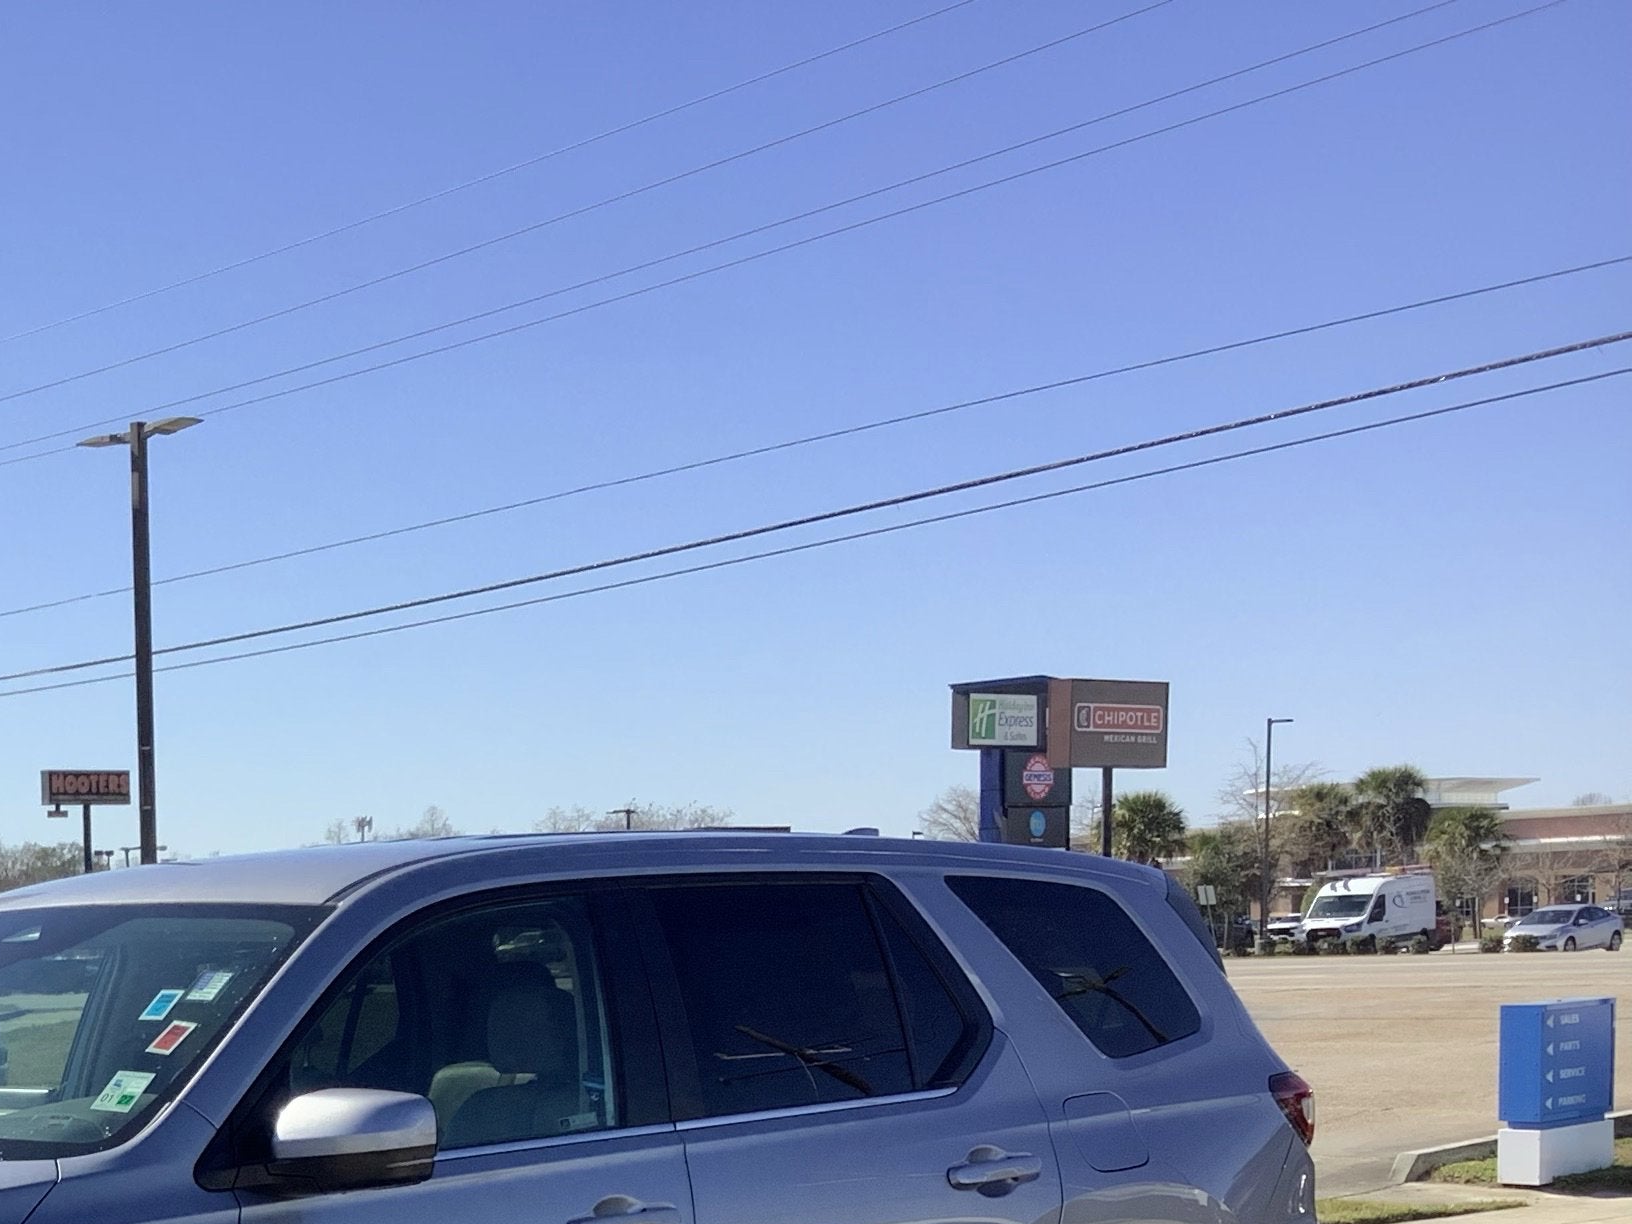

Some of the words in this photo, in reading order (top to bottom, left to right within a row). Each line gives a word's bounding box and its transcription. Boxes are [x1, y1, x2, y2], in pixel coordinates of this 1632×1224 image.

[999, 712, 1034, 730] Express
[1094, 710, 1158, 726] CHIPOTLE
[1104, 734, 1136, 743] MEXICAN
[1137, 735, 1158, 744] GRILL
[1024, 773, 1052, 782] GENESIS
[51, 774, 128, 794] HOOTERS
[1559, 1014, 1579, 1025] SALES
[1559, 1040, 1580, 1051] PARTS
[1559, 1067, 1585, 1079] SERVICE
[100, 1093, 114, 1103] 01
[1558, 1094, 1586, 1106] PARKING
